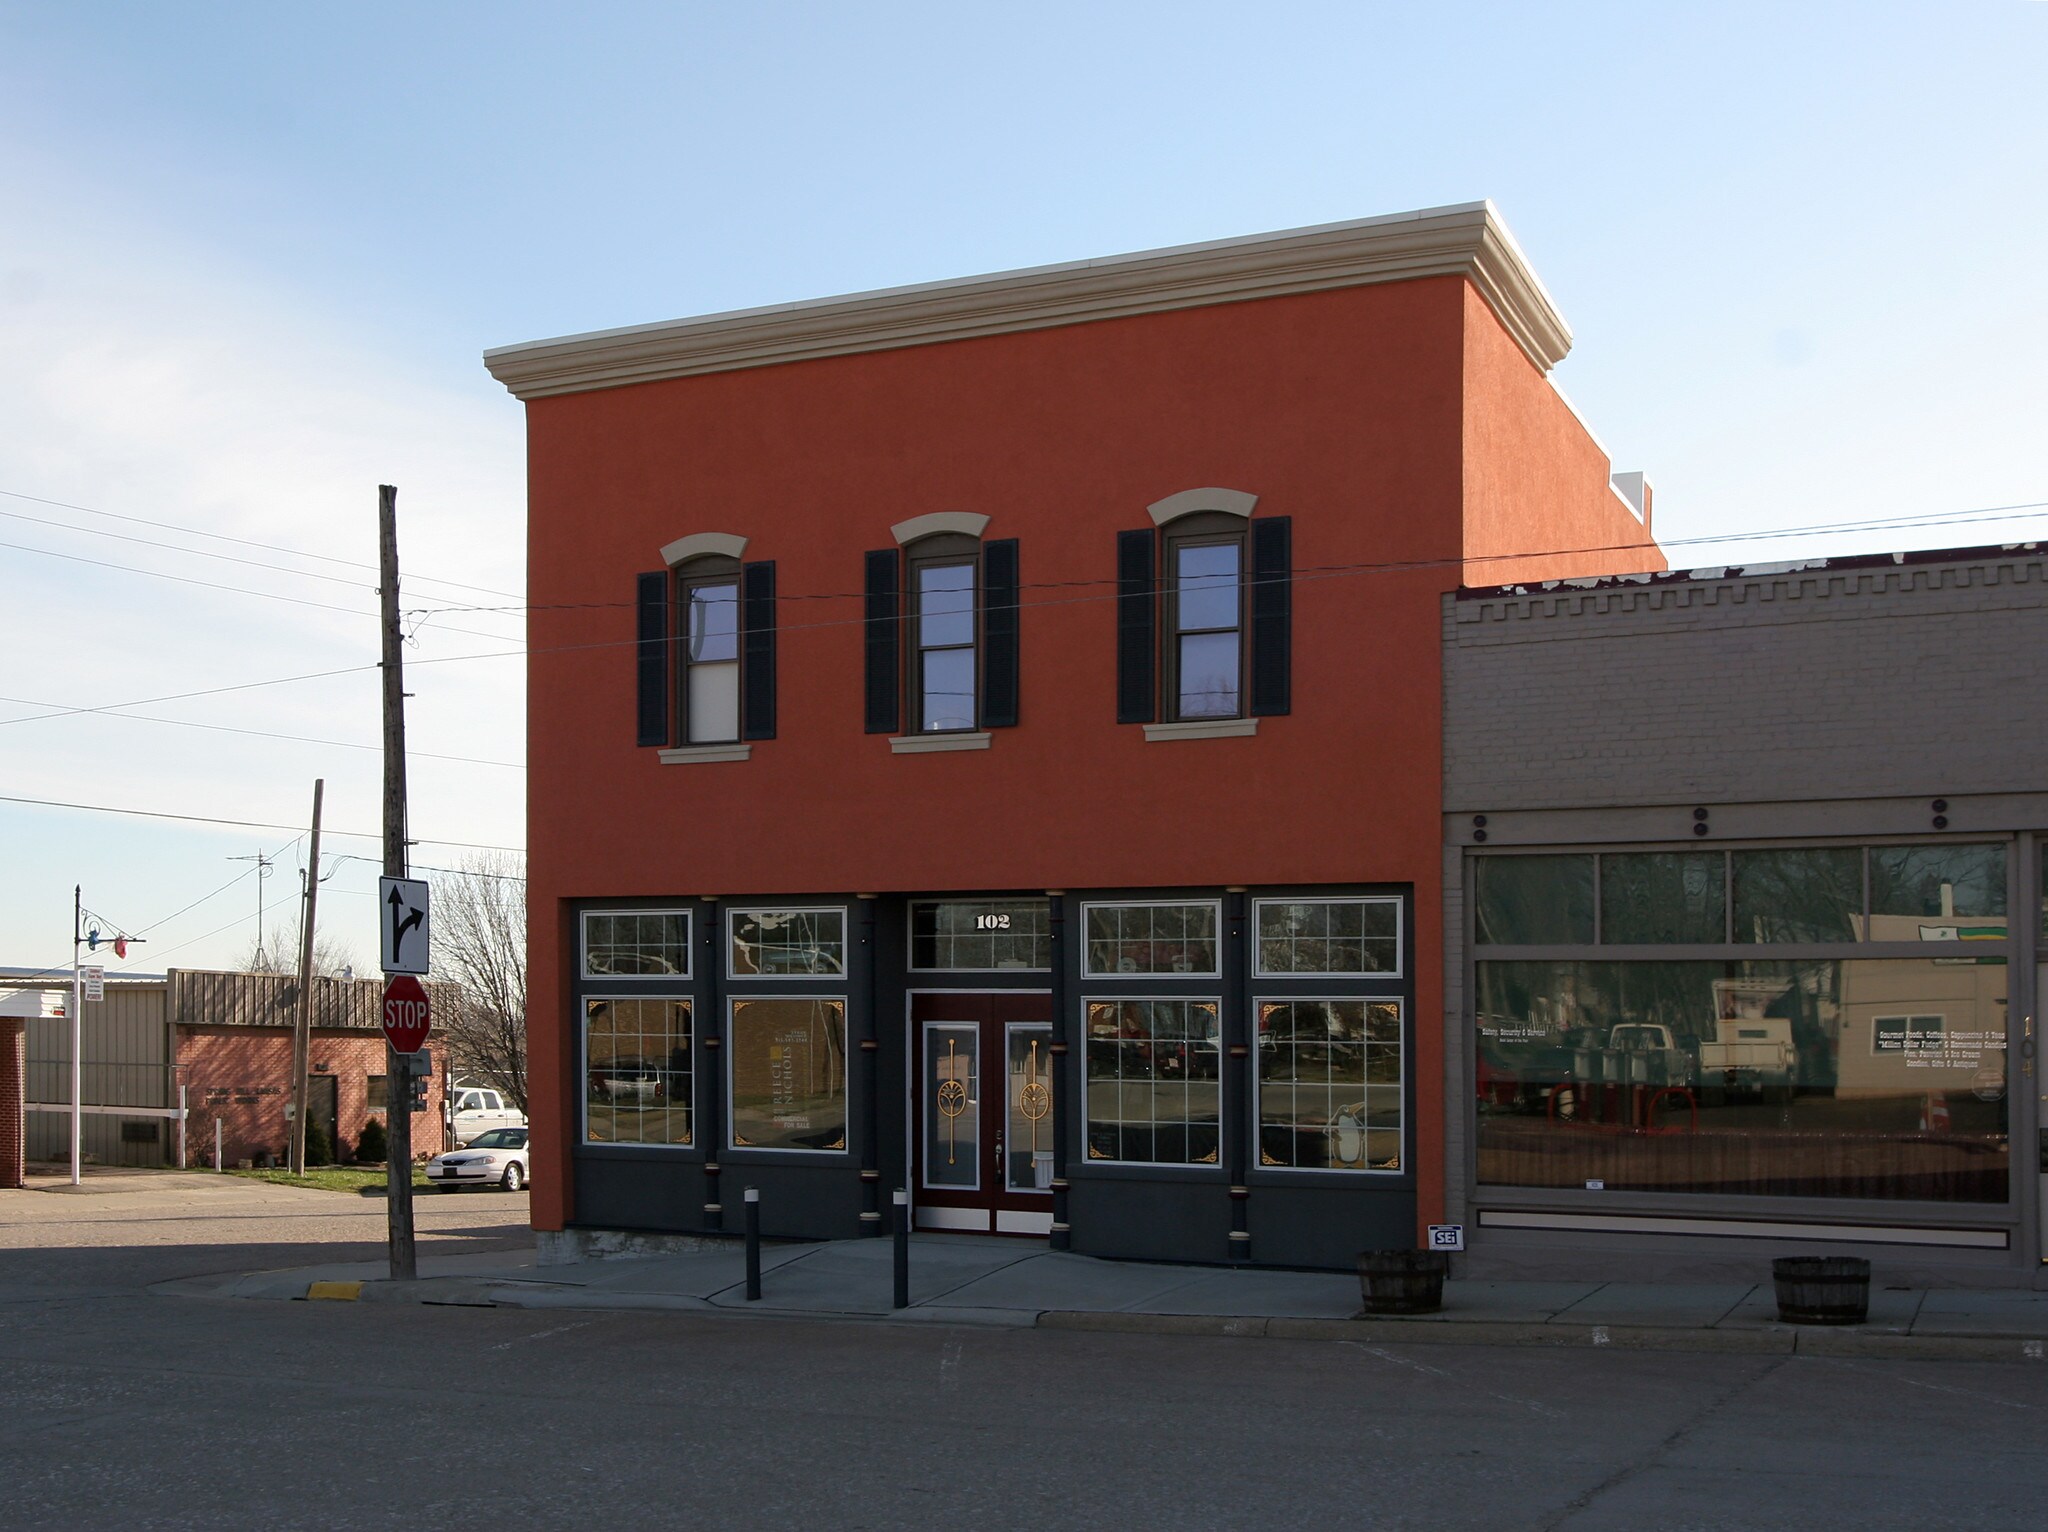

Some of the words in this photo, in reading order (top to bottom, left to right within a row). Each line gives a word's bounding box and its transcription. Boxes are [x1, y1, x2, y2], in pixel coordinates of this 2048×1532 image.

[976, 914, 1011, 929] 102
[386, 999, 427, 1029] STOP
[772, 1061, 782, 1104] REECE
[783, 1046, 793, 1105] NICHOLS
